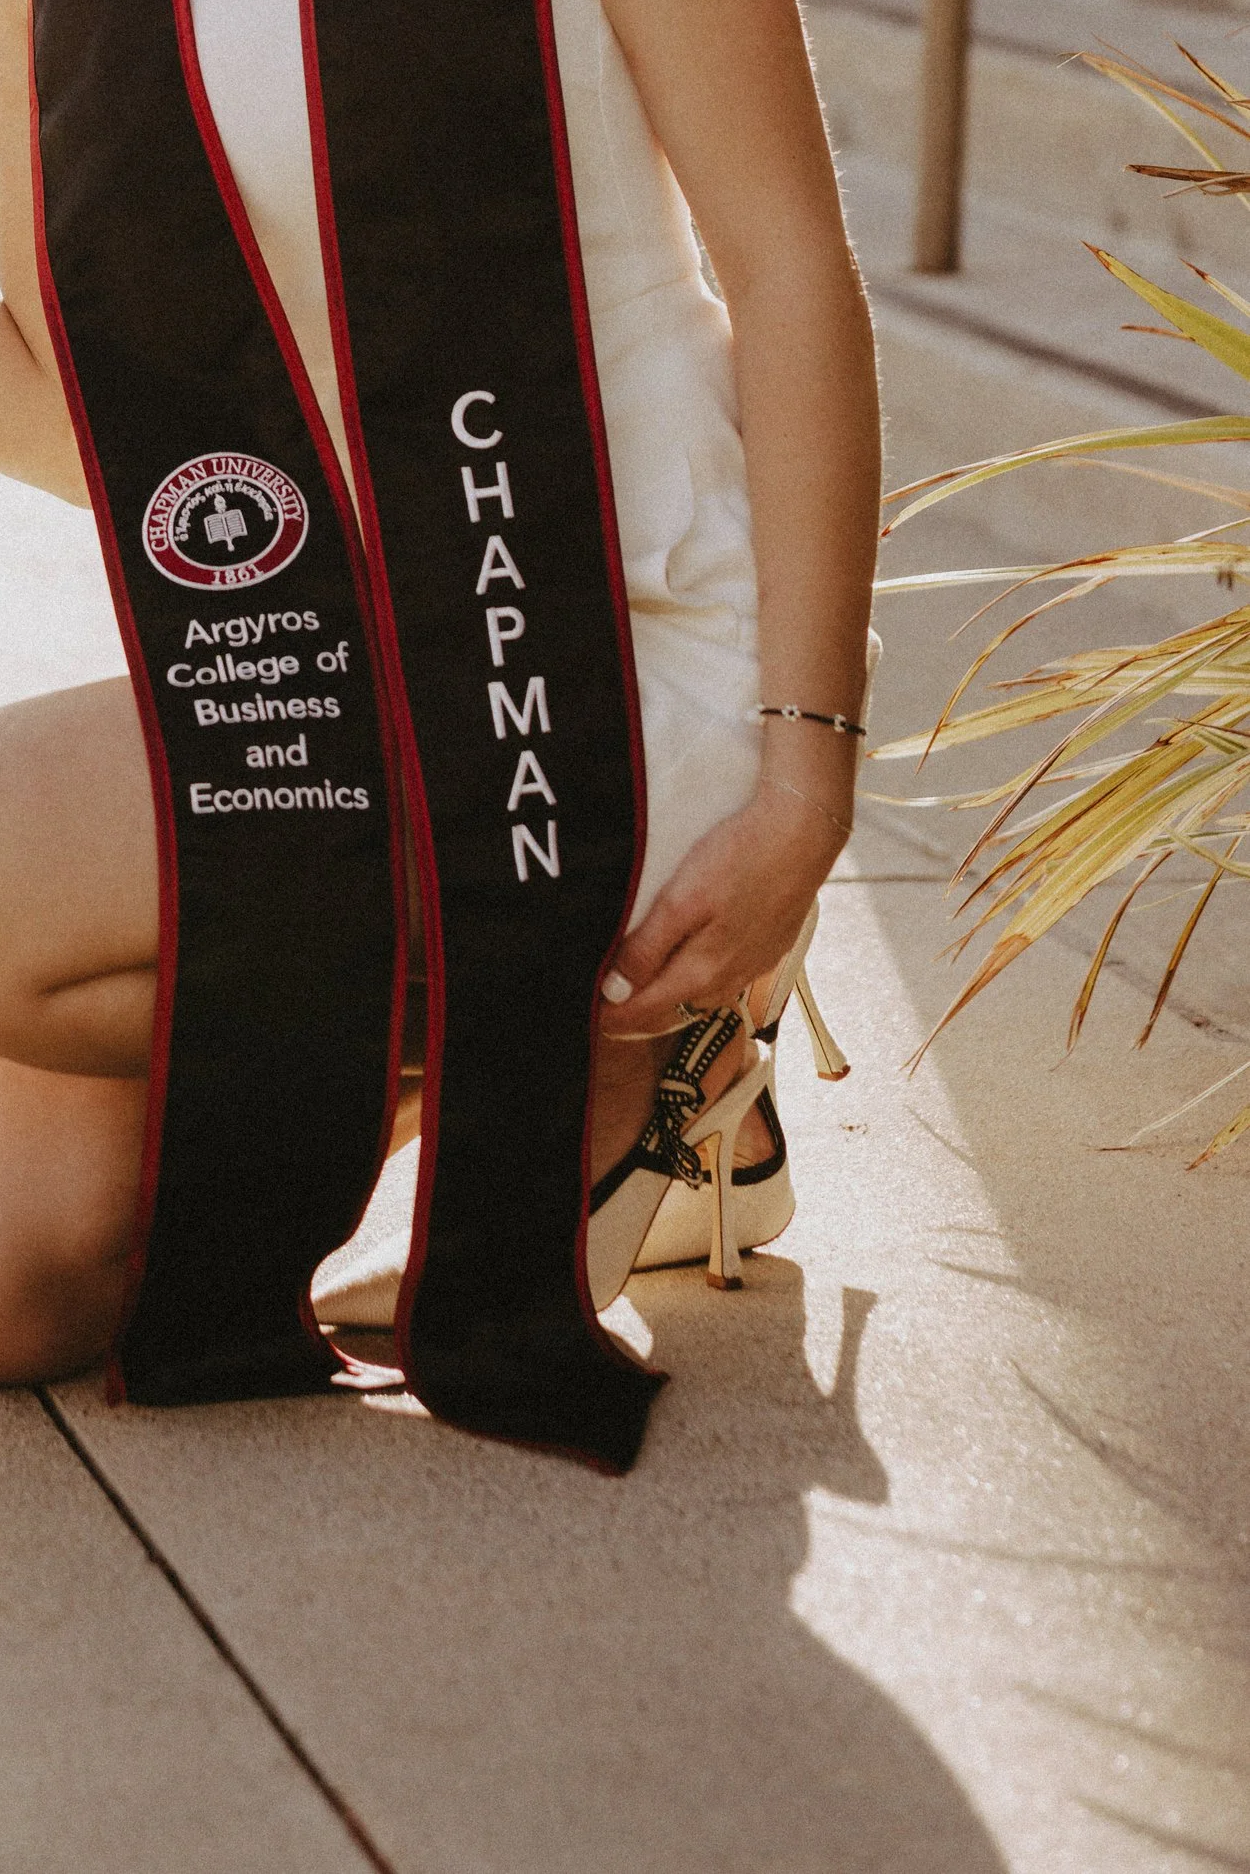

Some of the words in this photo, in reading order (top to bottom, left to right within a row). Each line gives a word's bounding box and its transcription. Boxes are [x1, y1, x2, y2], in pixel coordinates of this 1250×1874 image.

[150, 462, 206, 551] CHAPMAN
[212, 458, 301, 521] UNIVERSITY
[211, 564, 264, 585] 1861
[184, 610, 320, 649] Argyros
[450, 390, 561, 883] CHAPMAN
[167, 653, 300, 687] College
[316, 641, 349, 672] of
[194, 693, 341, 726] Business
[245, 733, 308, 769] and
[189, 778, 370, 814] Economics
